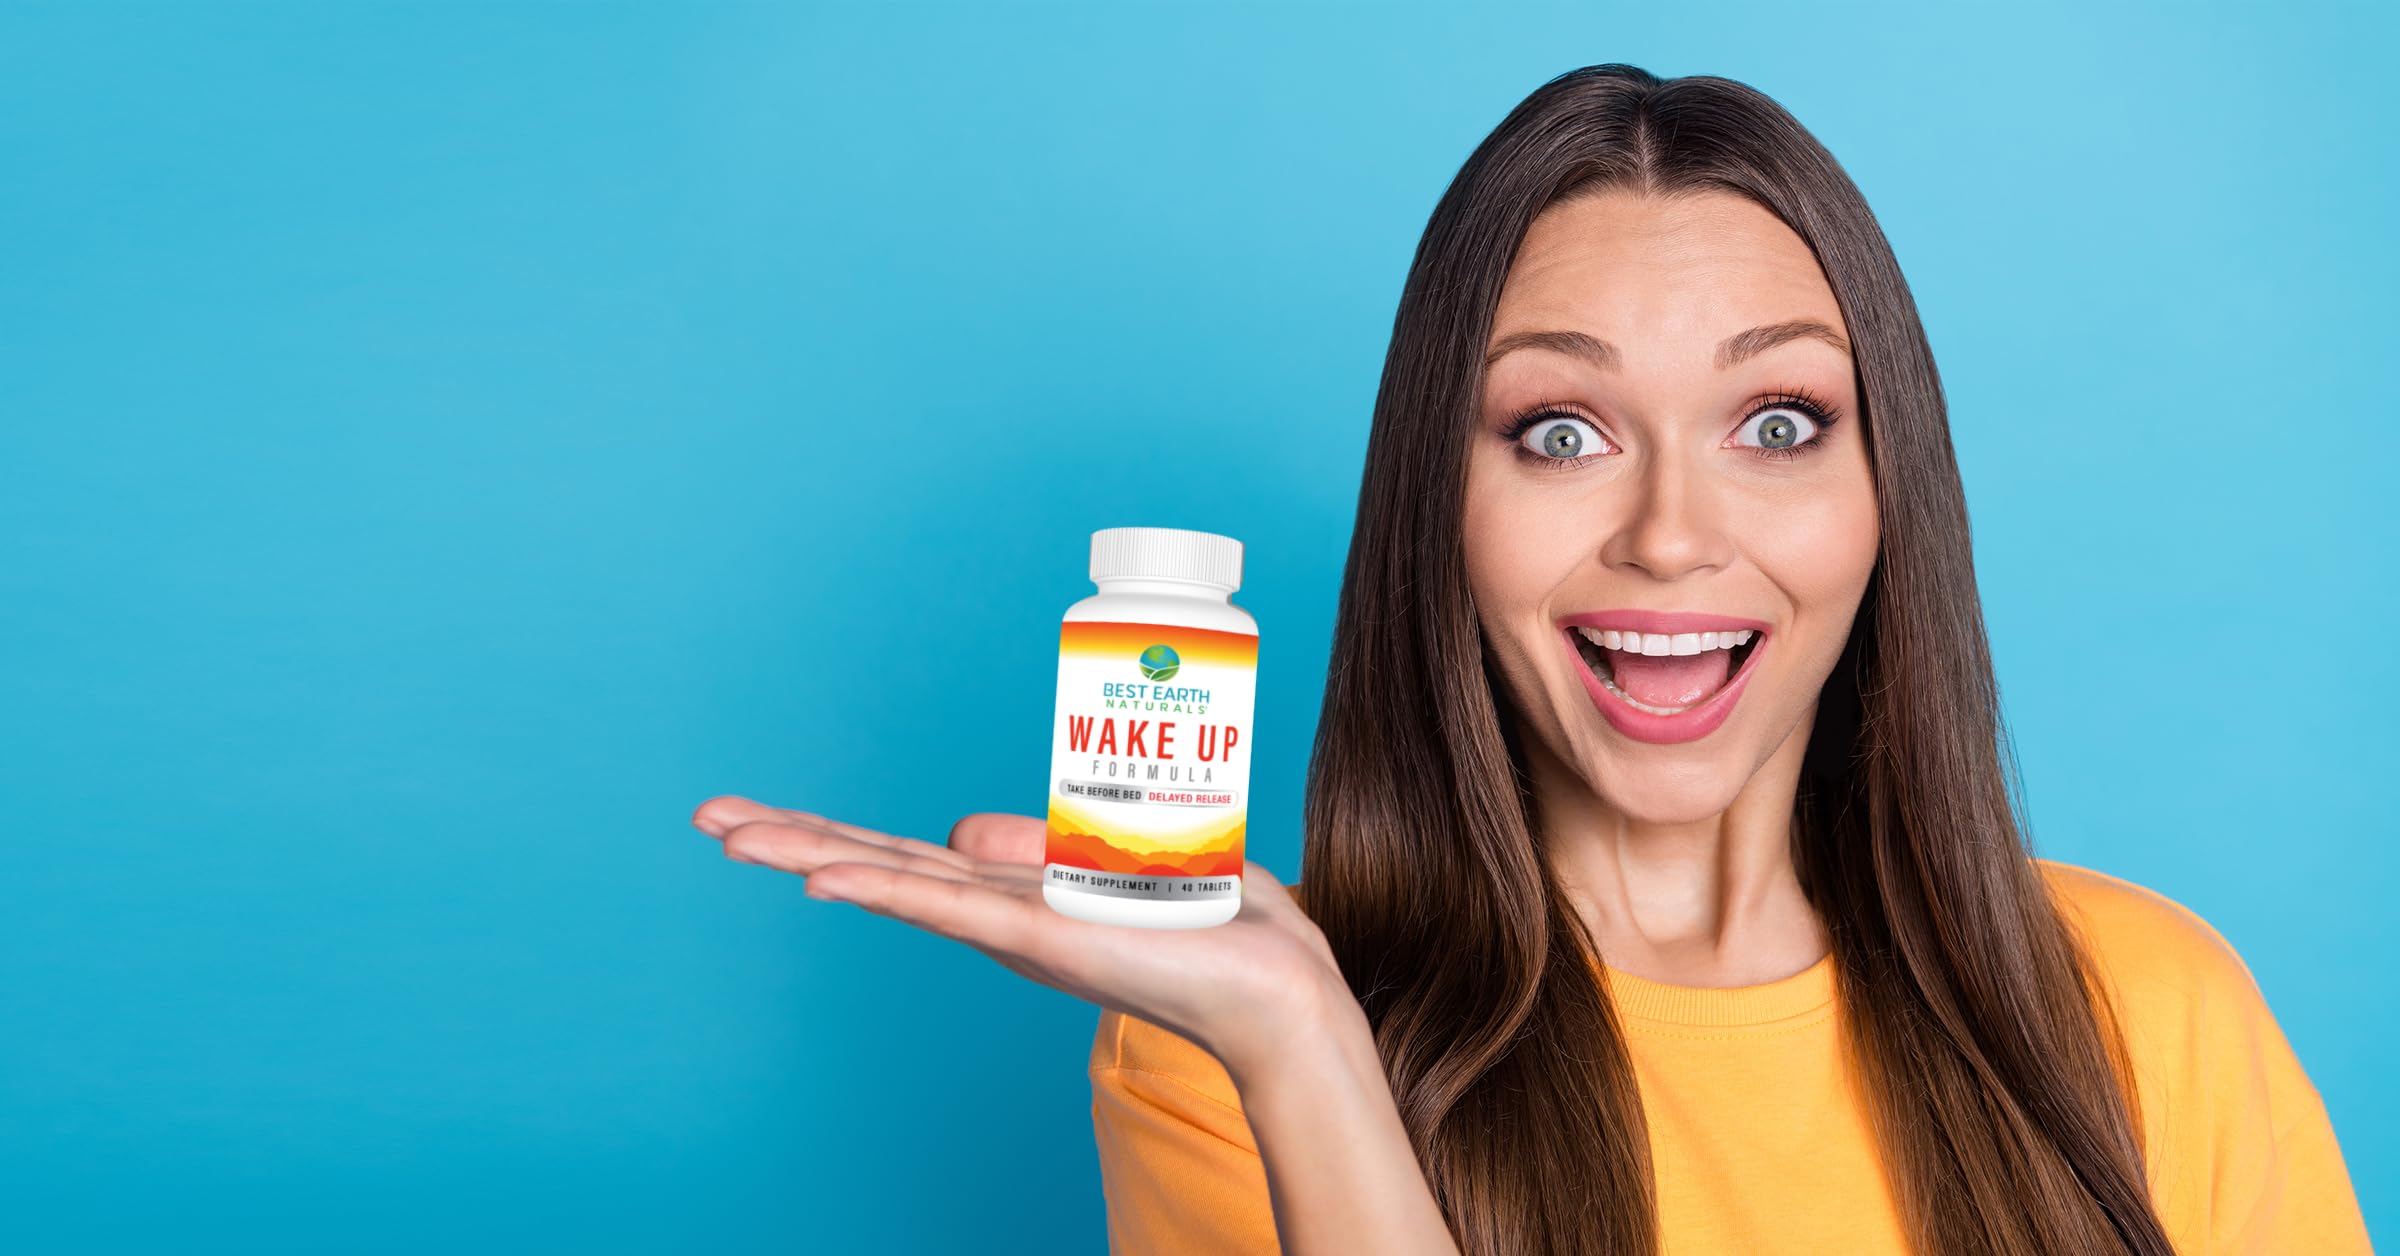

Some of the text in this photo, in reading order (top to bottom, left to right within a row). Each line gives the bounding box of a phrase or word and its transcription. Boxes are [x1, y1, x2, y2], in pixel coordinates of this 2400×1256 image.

[1103, 682, 1210, 704] BEST EARTH
[1069, 714, 1239, 763] WAKE UP
[1092, 760, 1212, 783] FORMULA
[1067, 784, 1142, 800] TAKE BEFORE BED
[1149, 791, 1231, 804] DELAYED RELEASE
[1052, 870, 1158, 891] DIETARY SUPPLEMENT
[1181, 882, 1231, 892] 40 TABLETS
